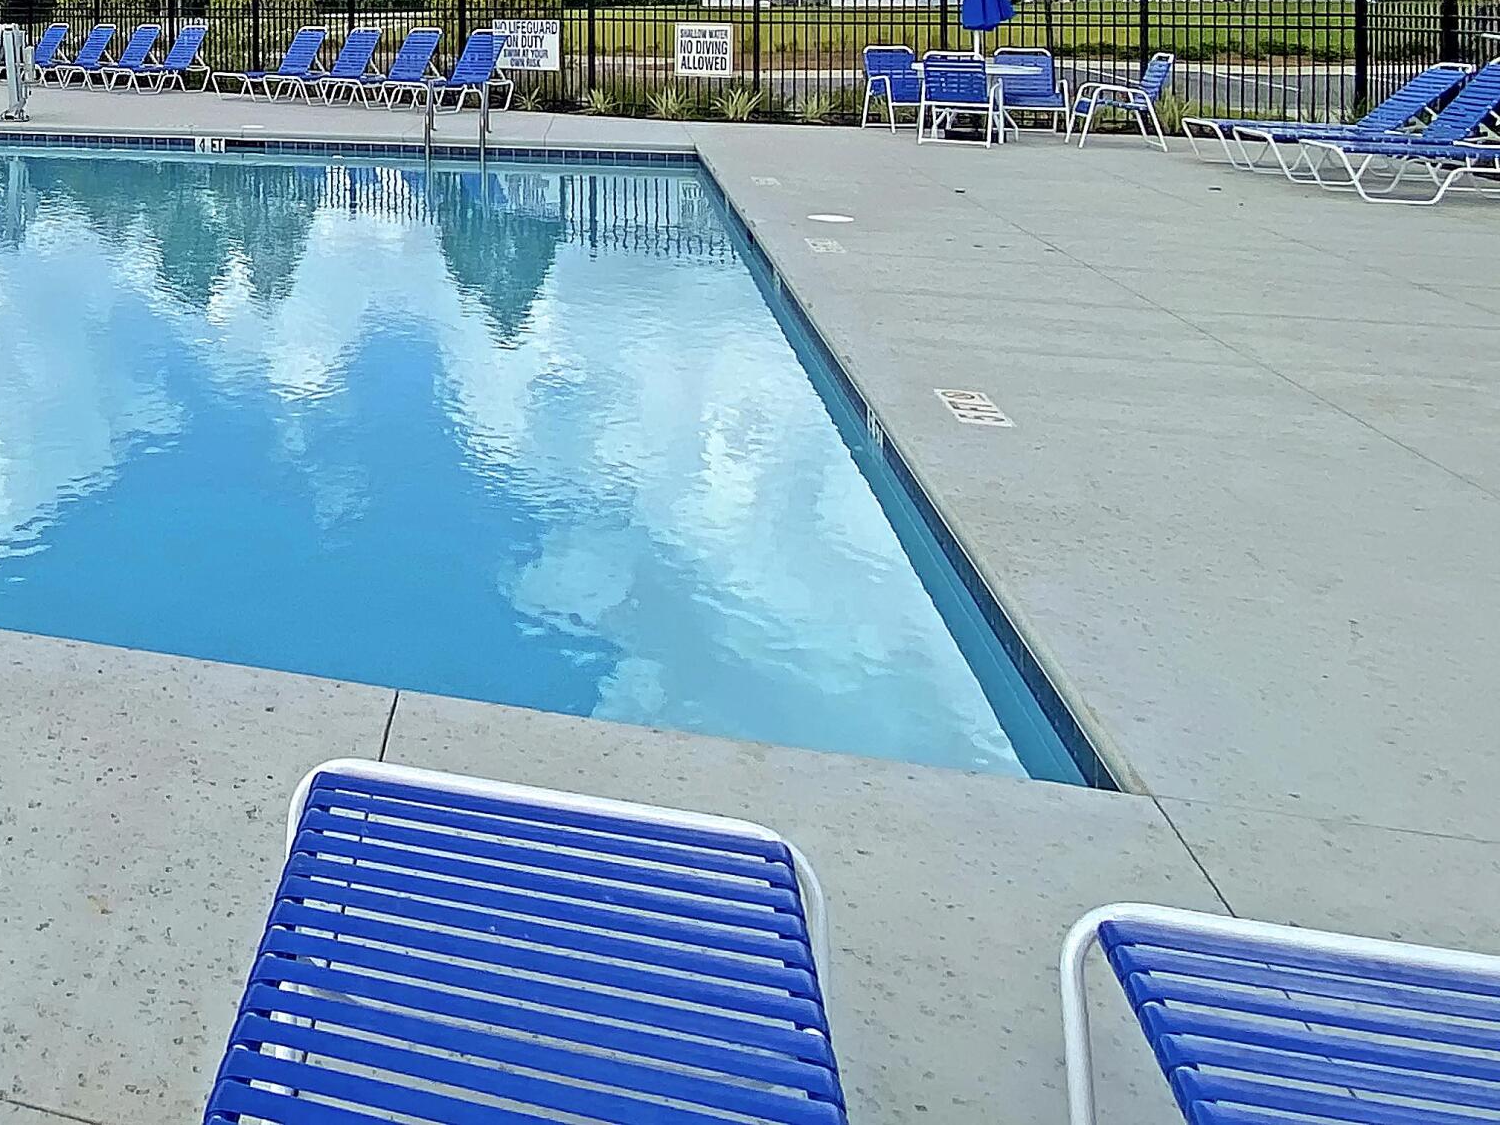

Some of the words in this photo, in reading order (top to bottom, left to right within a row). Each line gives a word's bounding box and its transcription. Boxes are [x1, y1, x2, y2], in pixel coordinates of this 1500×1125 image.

[494, 21, 507, 34] NO
[508, 21, 558, 34] LIFEGUARD
[680, 28, 707, 39] SHALLOW
[708, 29, 728, 39] WATER
[506, 35, 519, 48] ON
[521, 35, 545, 48] DUTY
[680, 39, 693, 54] NO
[696, 40, 728, 55] DIVING
[531, 49, 548, 59] YOUR
[680, 55, 727, 71] ALLOWED
